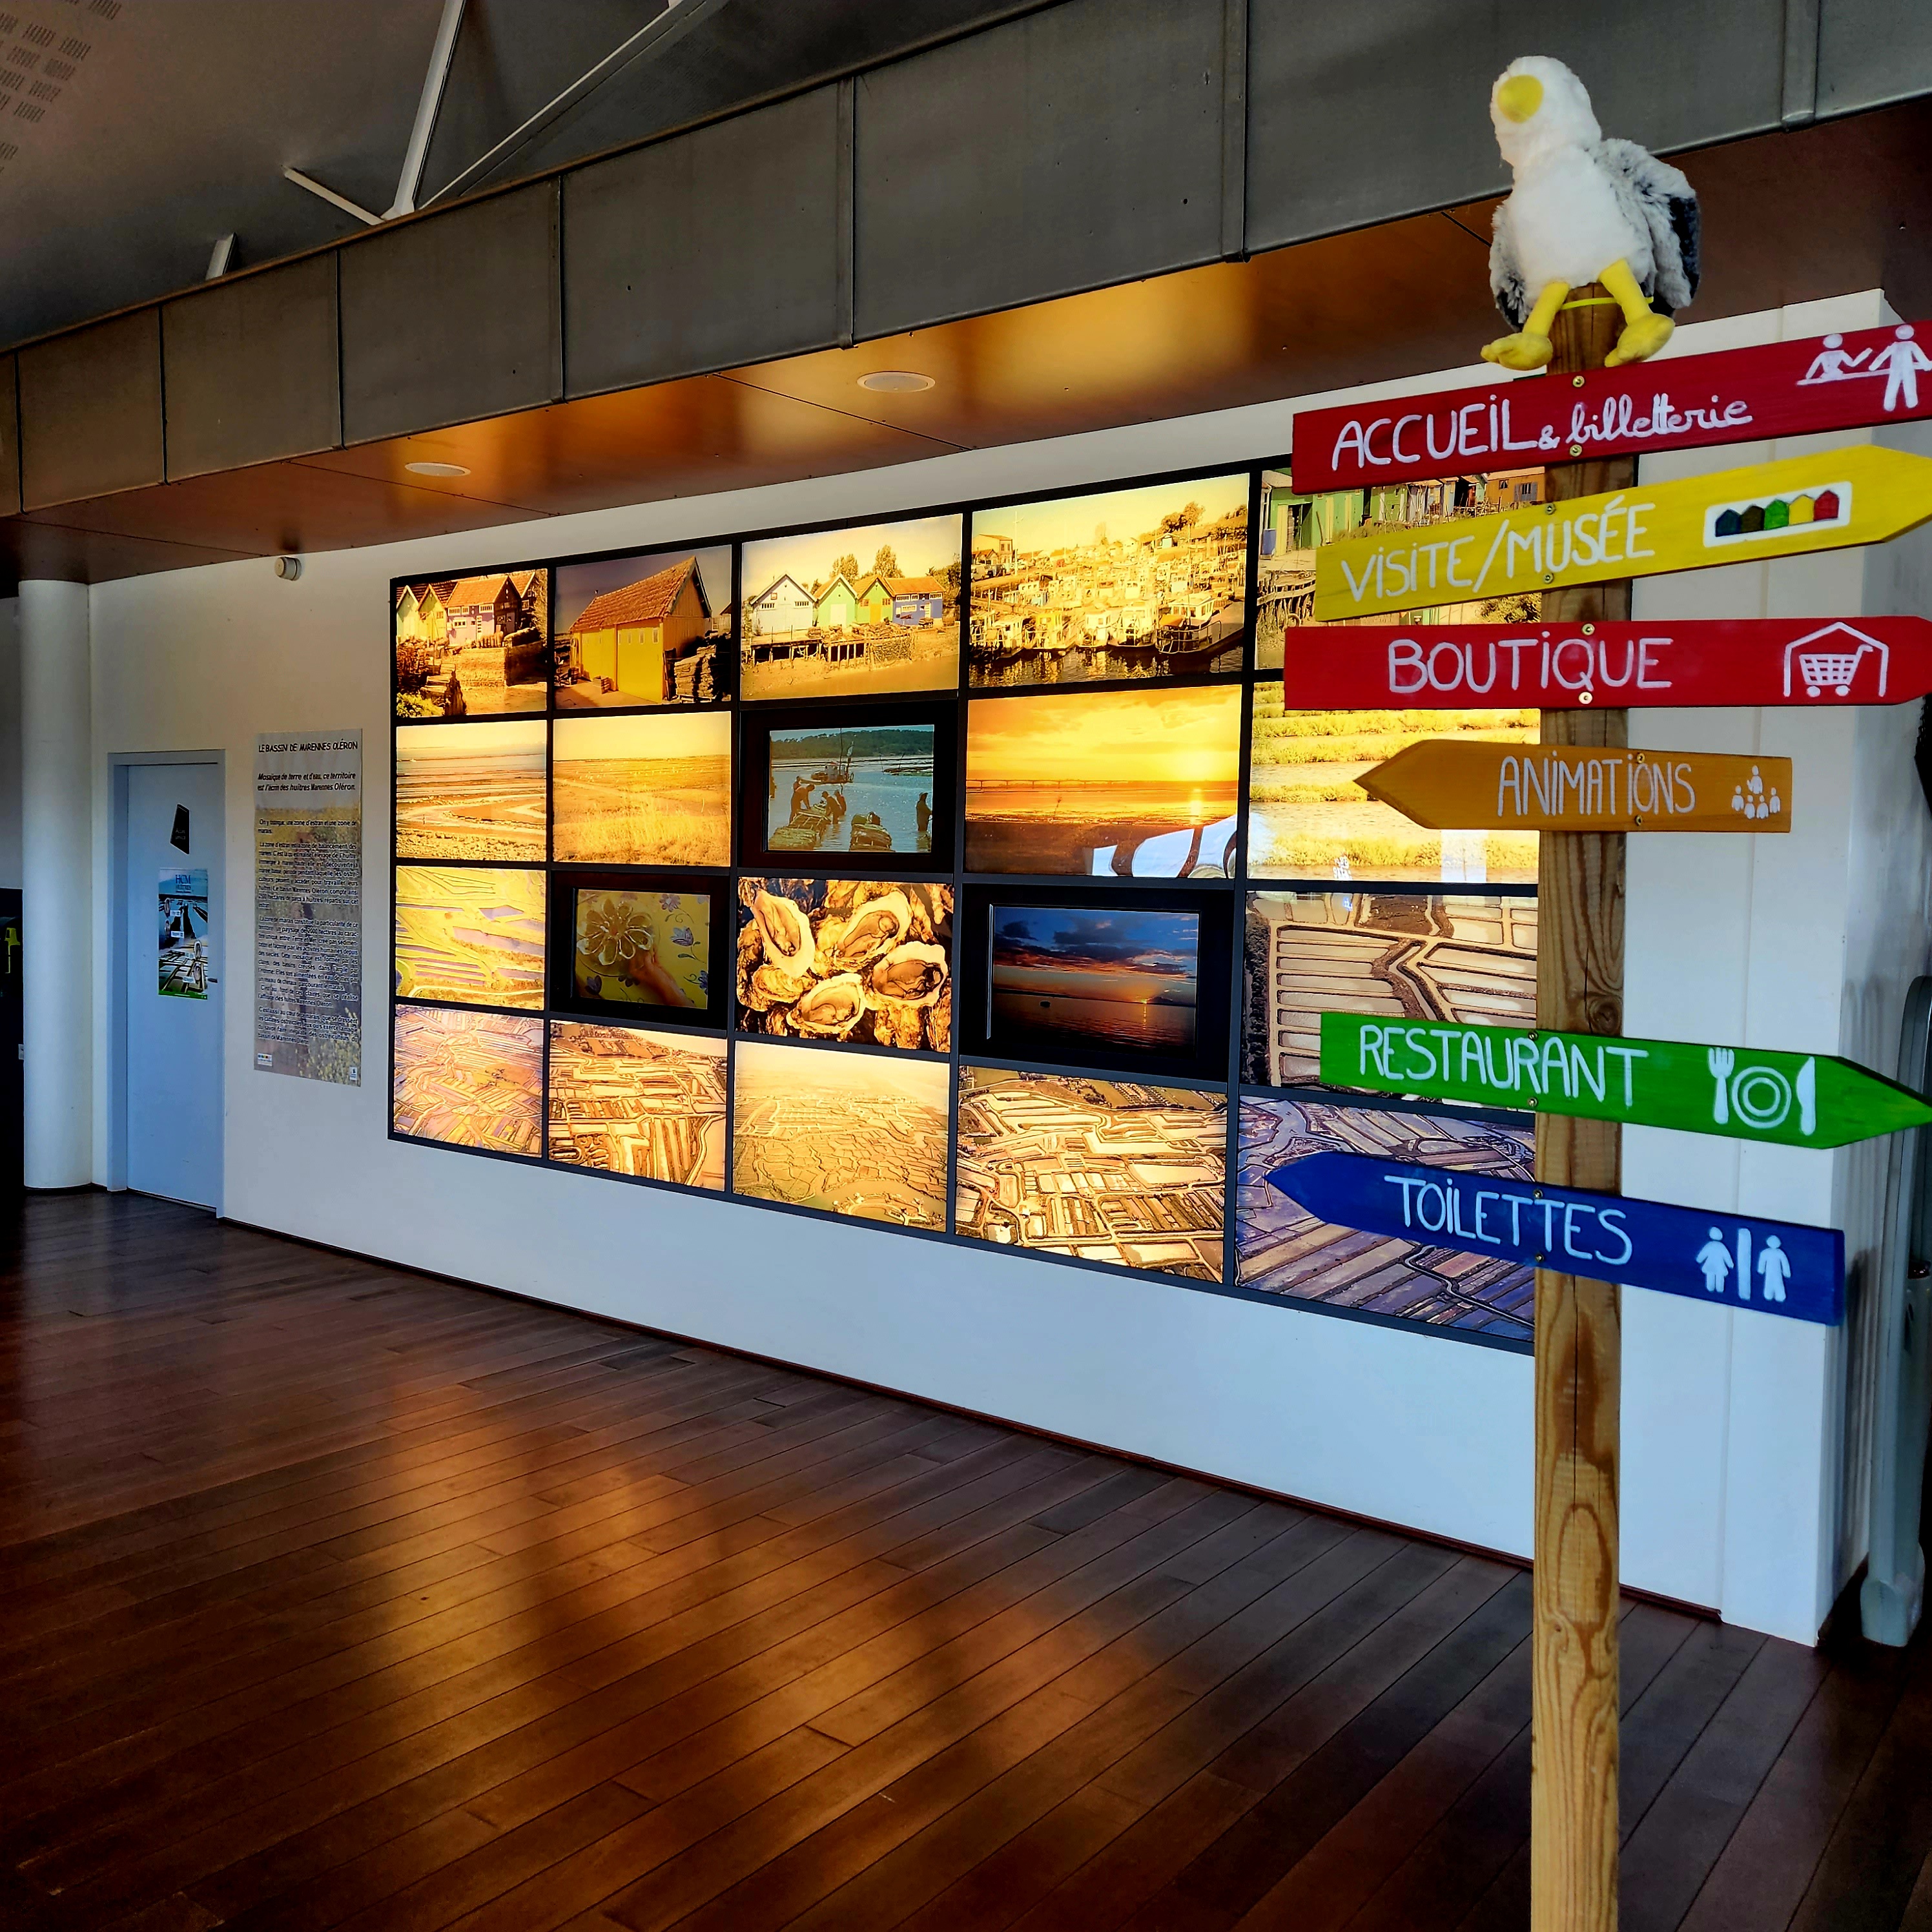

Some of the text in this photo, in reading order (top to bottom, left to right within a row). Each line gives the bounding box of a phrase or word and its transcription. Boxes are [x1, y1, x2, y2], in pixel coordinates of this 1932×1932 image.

[1332, 393, 1753, 470] ACCUEIL & billetterie
[1388, 630, 1673, 694] BOUTIQUE
[290, 743, 297, 752] DE
[299, 743, 331, 751] MARENNES
[333, 739, 358, 750] OLÉRON
[1497, 751, 1696, 816] ANIMATIONS
[176, 874, 190, 884] HCM
[1360, 1025, 1649, 1106] RESTAURANT
[1384, 1175, 1632, 1264] TOILETTES
